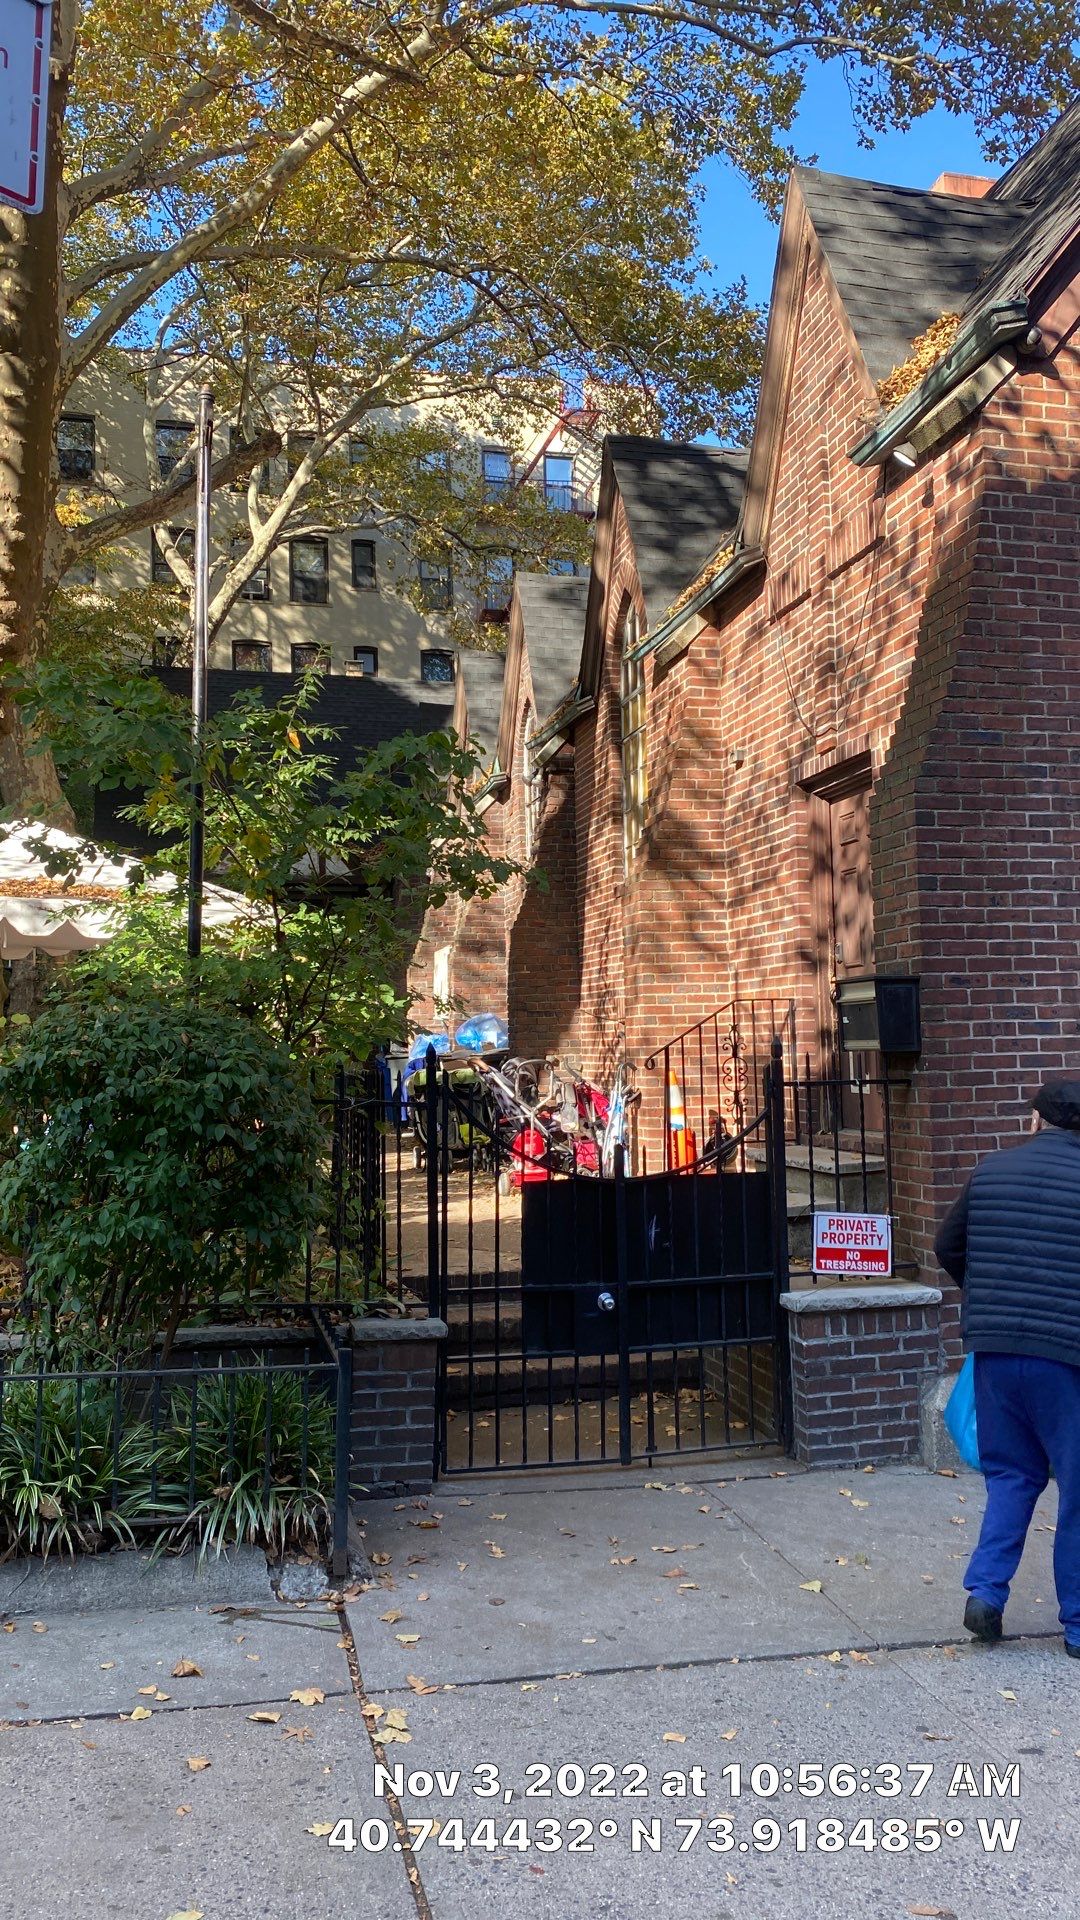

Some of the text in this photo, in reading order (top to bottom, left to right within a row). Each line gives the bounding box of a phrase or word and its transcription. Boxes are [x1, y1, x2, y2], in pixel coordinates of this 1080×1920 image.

[828, 1219, 877, 1232] PRIVATE
[821, 1232, 884, 1245] PROPERTY
[846, 1251, 860, 1260] NO
[820, 1260, 885, 1271] TRESPASSING
